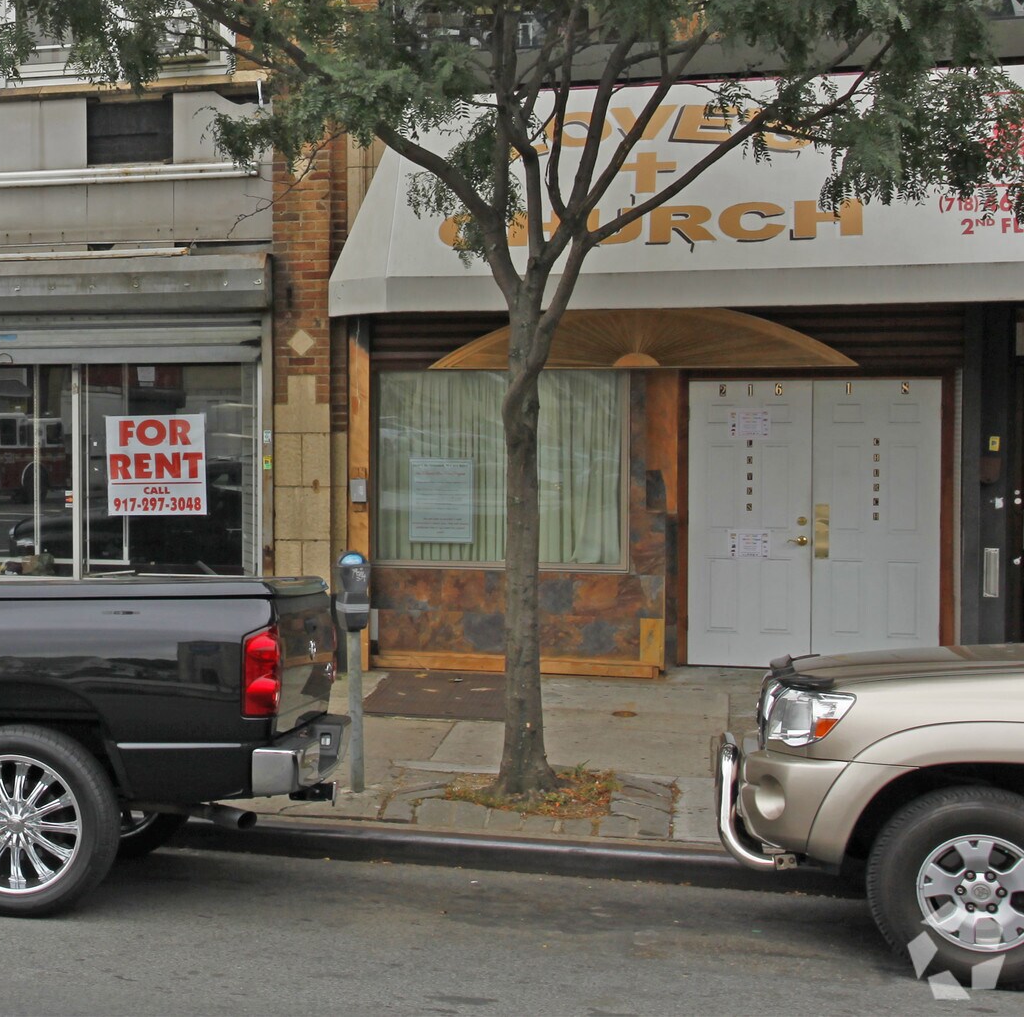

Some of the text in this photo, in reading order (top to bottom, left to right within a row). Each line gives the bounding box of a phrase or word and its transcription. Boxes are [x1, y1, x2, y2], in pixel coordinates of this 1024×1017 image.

[939, 194, 979, 213] (718)
[118, 419, 192, 447] FOR
[109, 452, 203, 480] RENT
[143, 486, 171, 495] CALL
[113, 496, 202, 512] 917-297-3048
